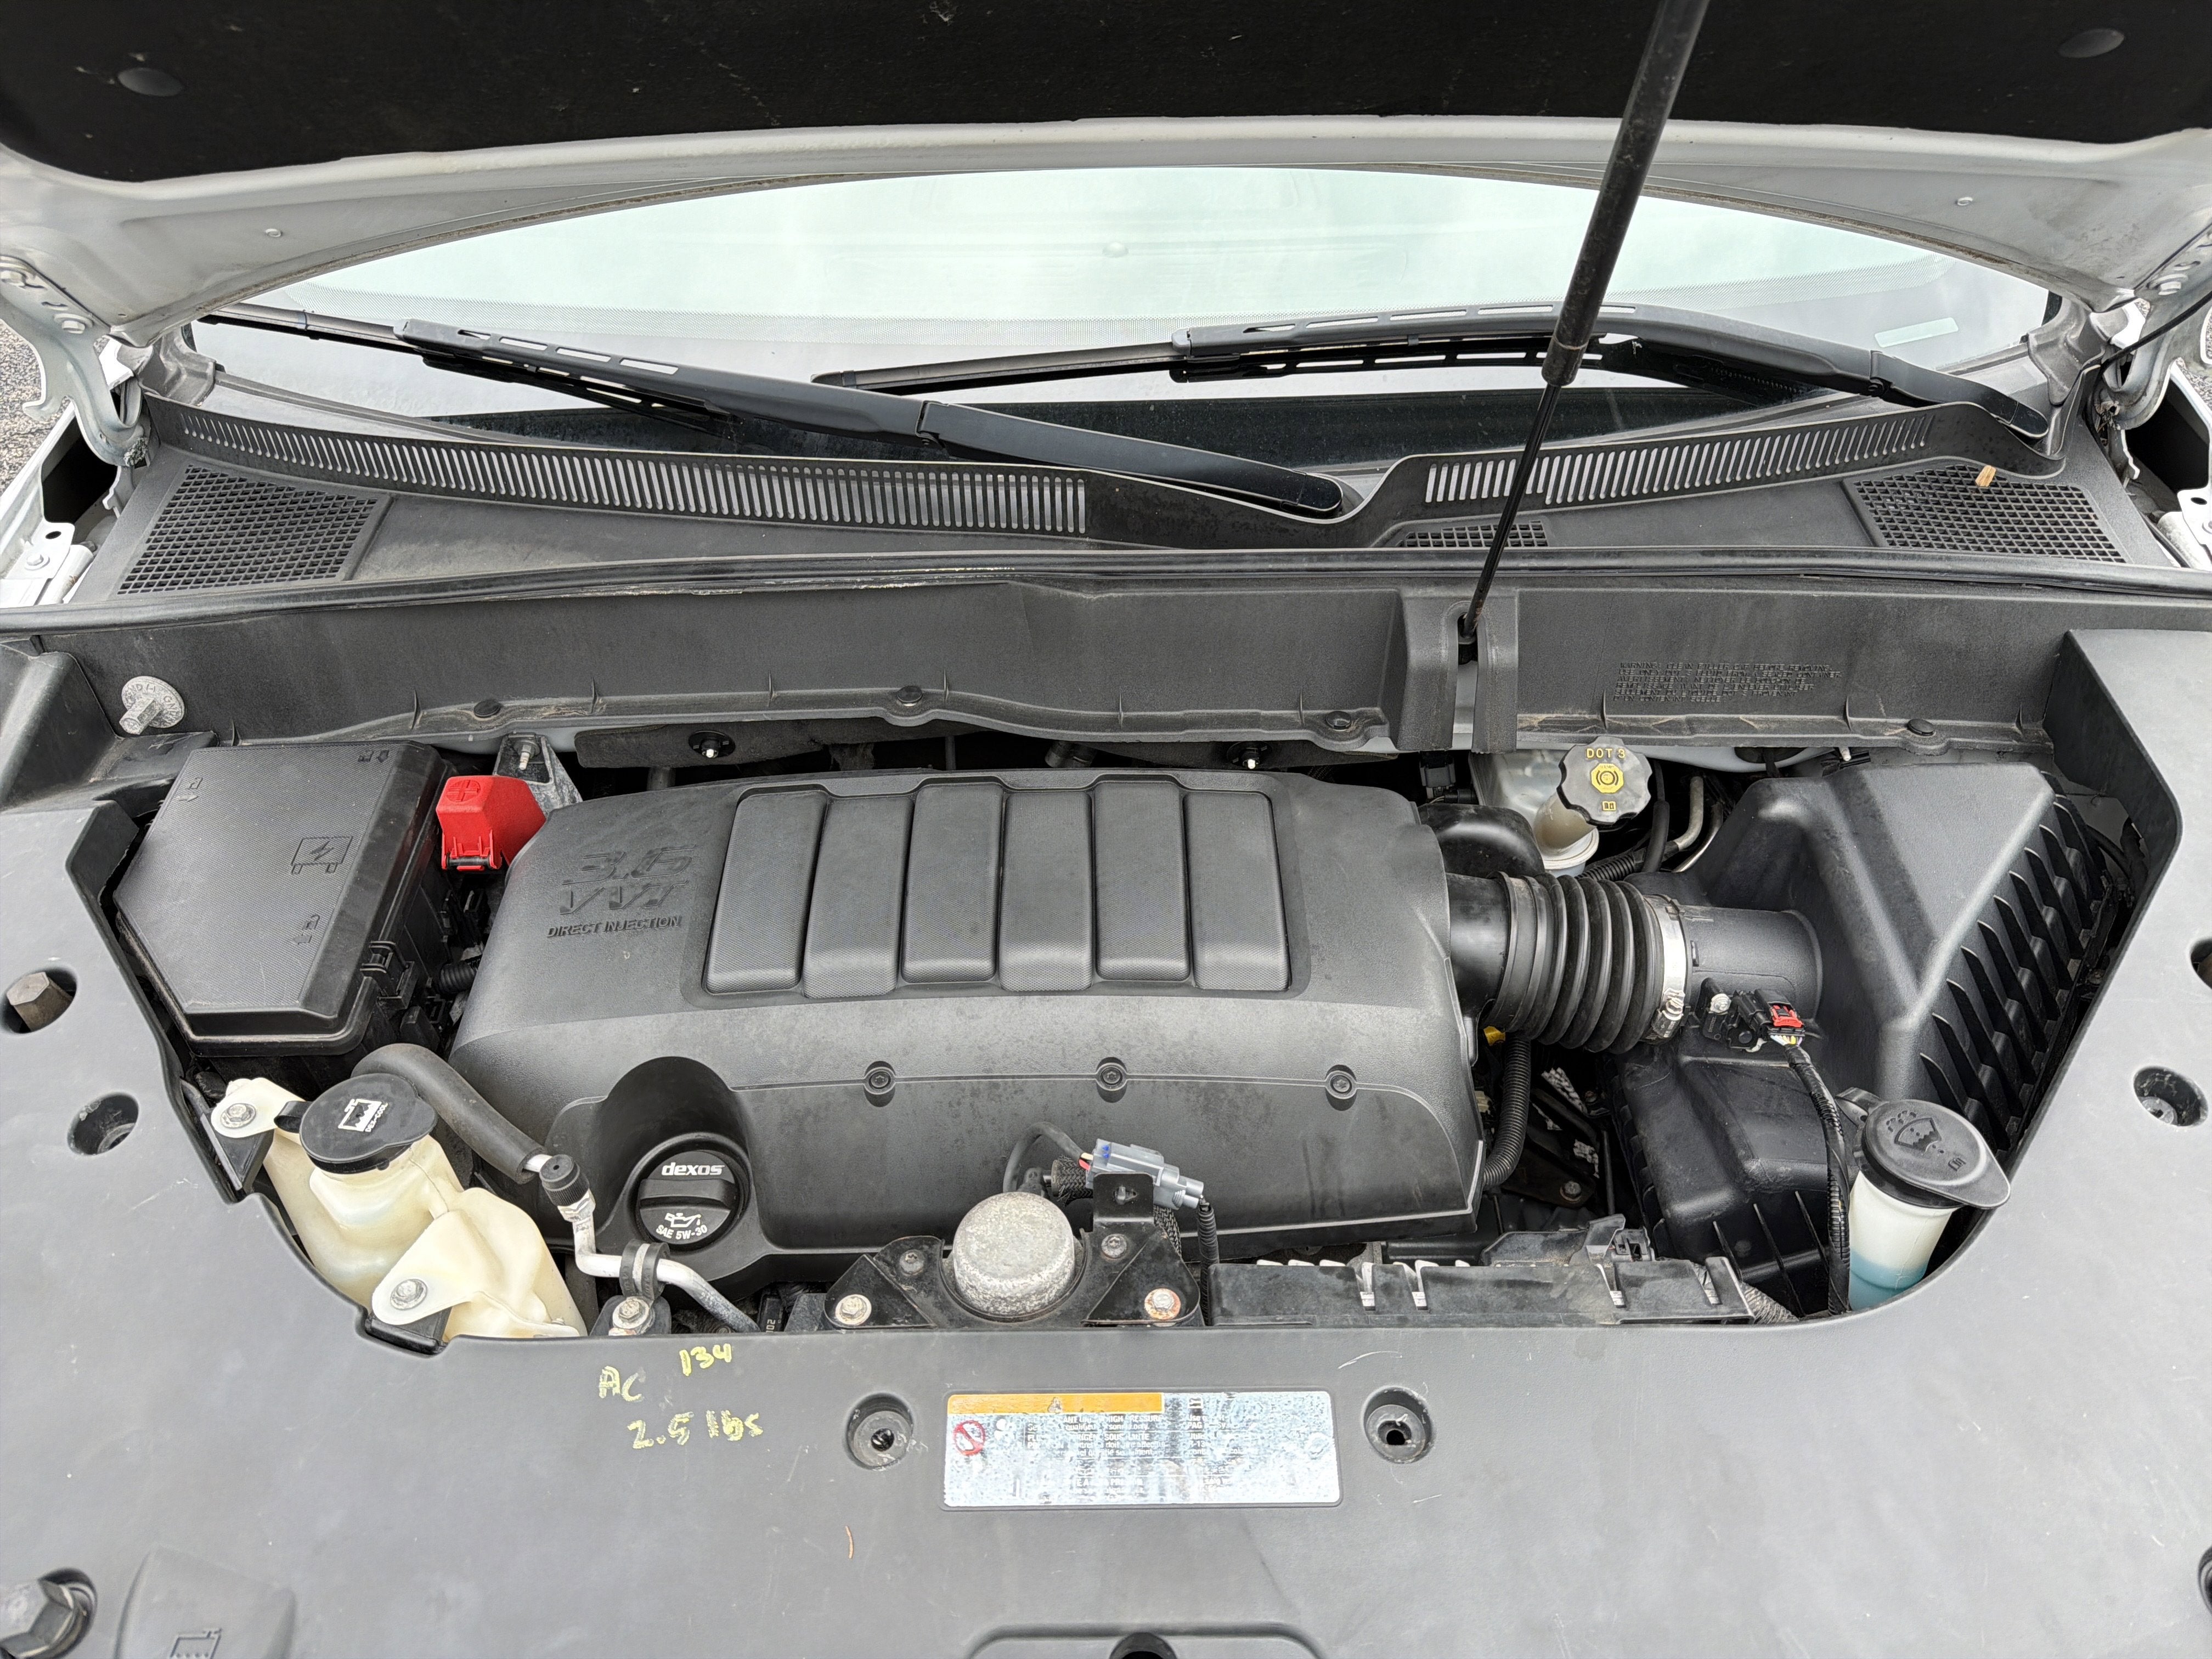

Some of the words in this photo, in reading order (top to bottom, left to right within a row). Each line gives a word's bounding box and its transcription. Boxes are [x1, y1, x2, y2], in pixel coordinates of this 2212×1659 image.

[1586, 748, 1613, 759] DOT
[1618, 748, 1626, 759] 3
[547, 922, 602, 938] DIRECT
[603, 915, 682, 933] INJECTION
[661, 1162, 725, 1176] dexos
[656, 1224, 674, 1239] SAE
[675, 1224, 708, 1240] 5W-30
[599, 1365, 646, 1402] AC
[679, 1343, 732, 1376] 134
[627, 1411, 695, 1449] 2.5
